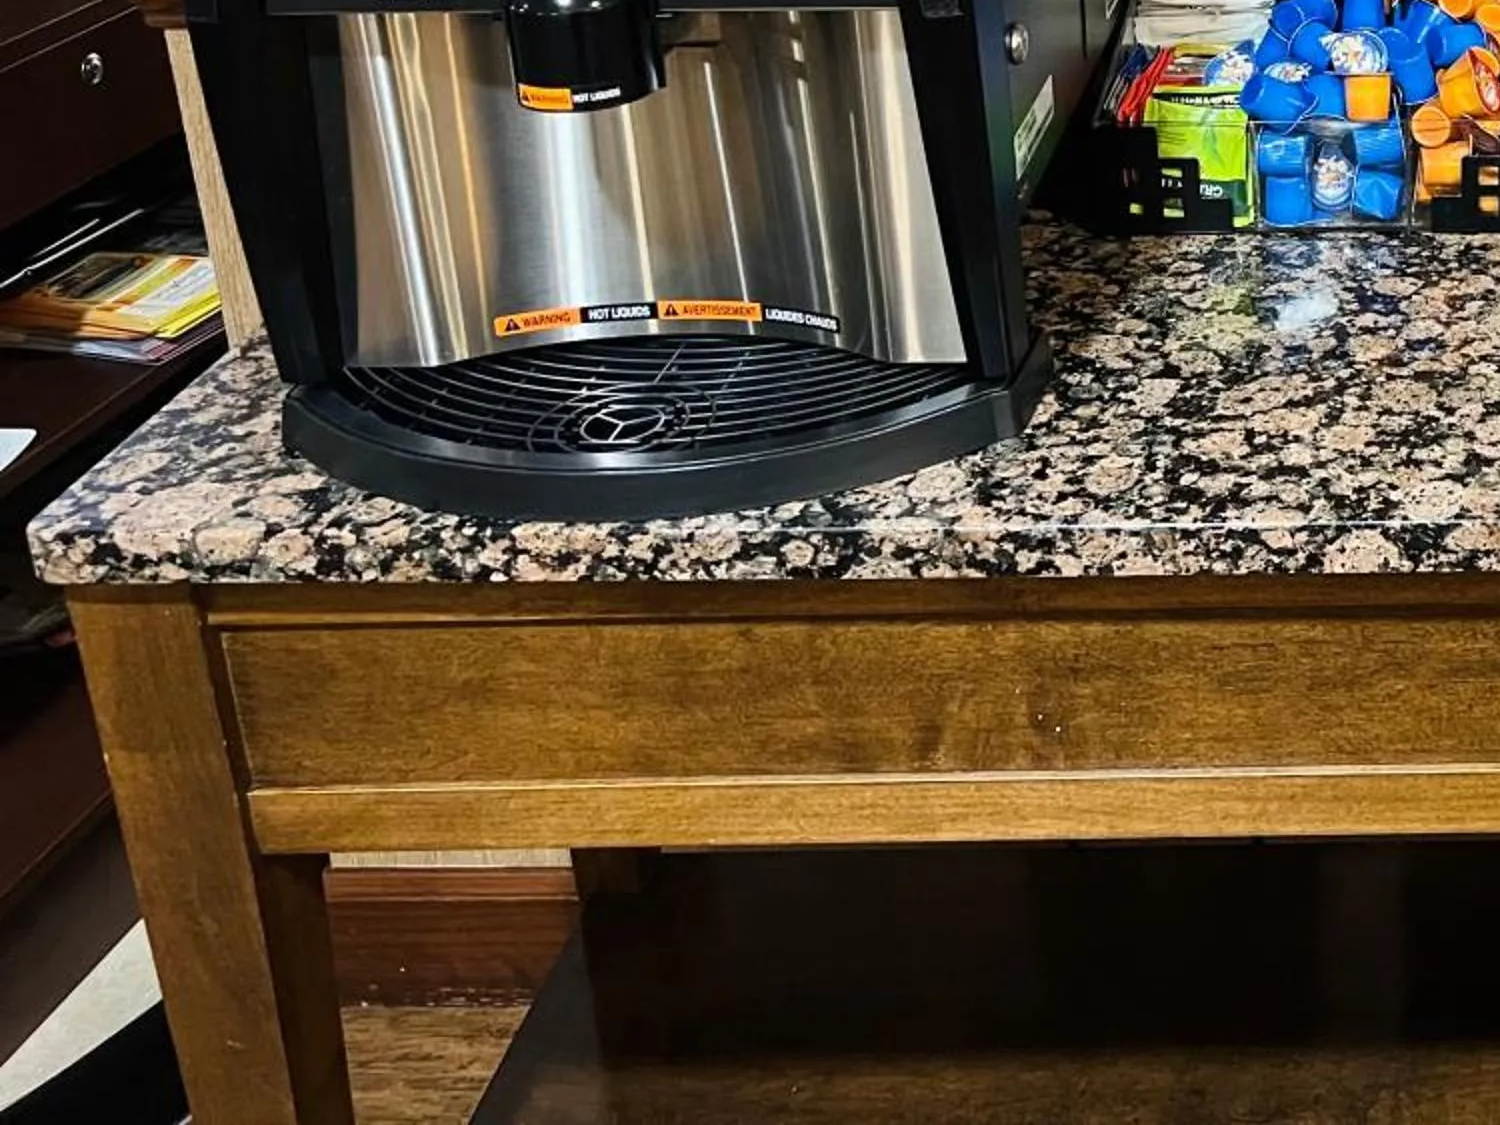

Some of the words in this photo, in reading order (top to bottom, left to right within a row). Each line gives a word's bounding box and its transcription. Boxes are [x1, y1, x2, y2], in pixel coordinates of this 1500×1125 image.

[521, 310, 572, 328] WARNING
[588, 306, 610, 320] HOT
[611, 304, 652, 319] LIQUIDS
[682, 303, 757, 317] AVERTISSEMENT
[764, 307, 804, 324] LIQUIDES
